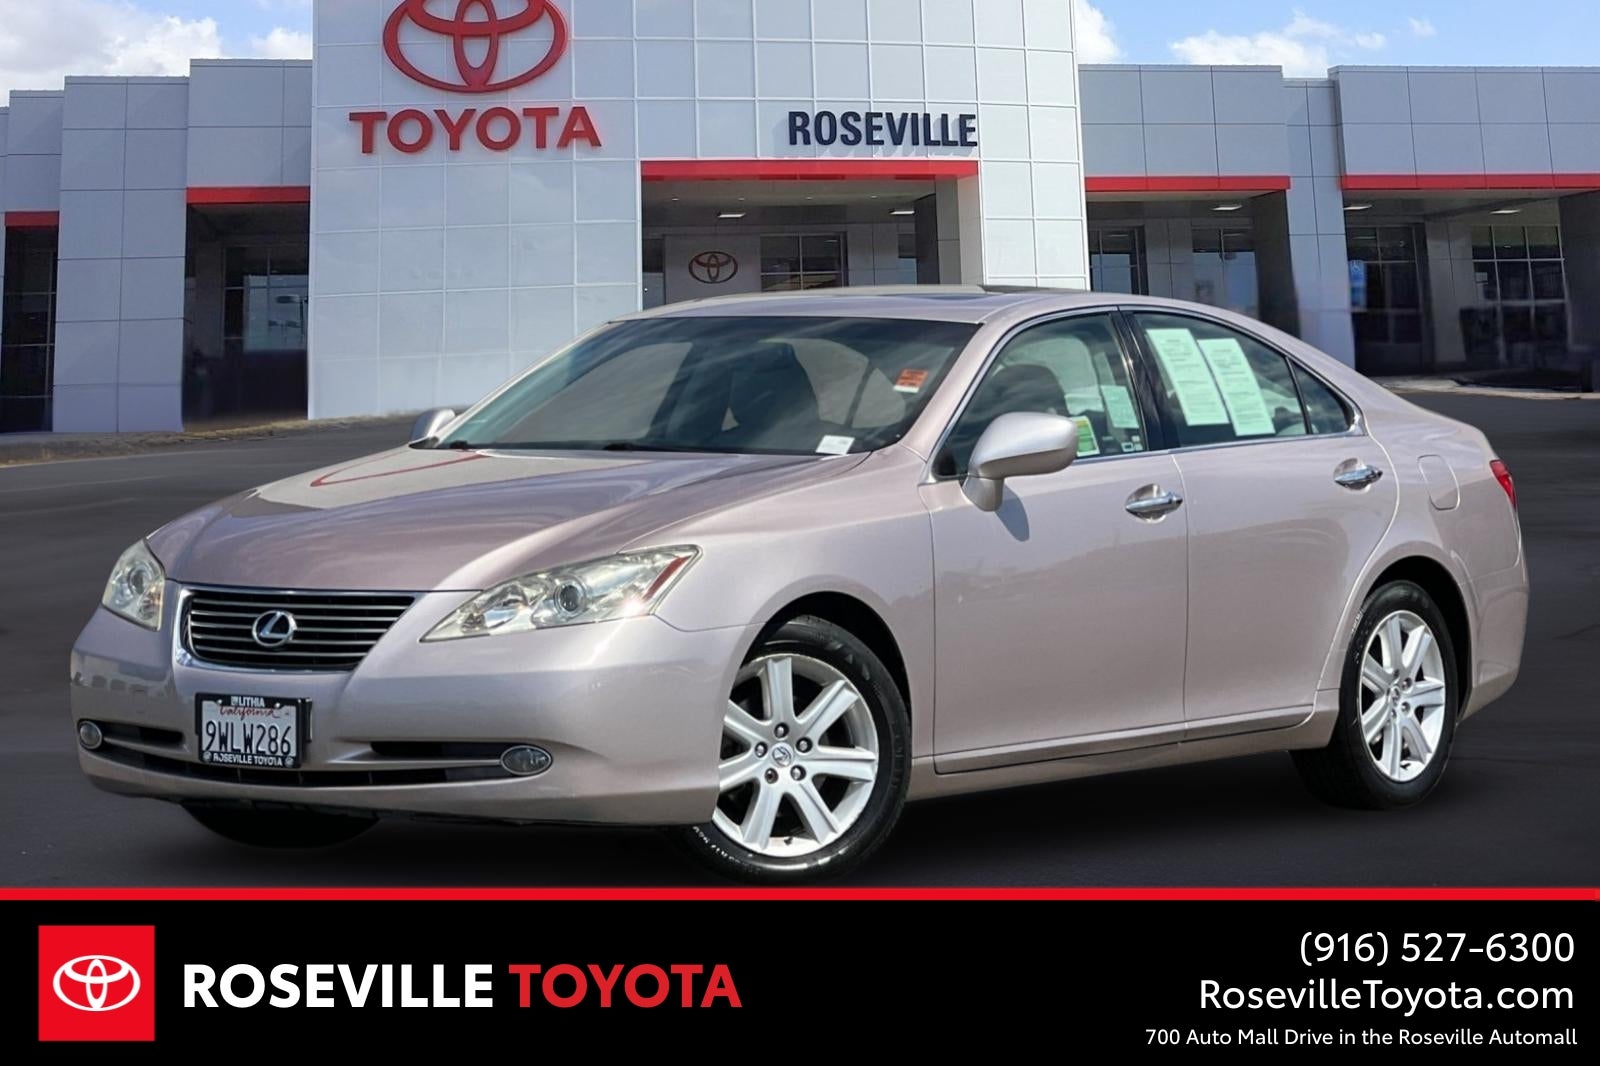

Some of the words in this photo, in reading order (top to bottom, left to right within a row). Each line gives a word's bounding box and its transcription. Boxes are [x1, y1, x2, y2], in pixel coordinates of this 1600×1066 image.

[349, 106, 602, 154] TOYOTA
[788, 111, 978, 148] ROSEVILLE
[220, 705, 281, 720] California
[238, 696, 265, 707] LITHIA
[205, 720, 291, 755] 9WLW286
[213, 752, 253, 764] ROSEVILLE
[254, 755, 283, 766] TOYOTA
